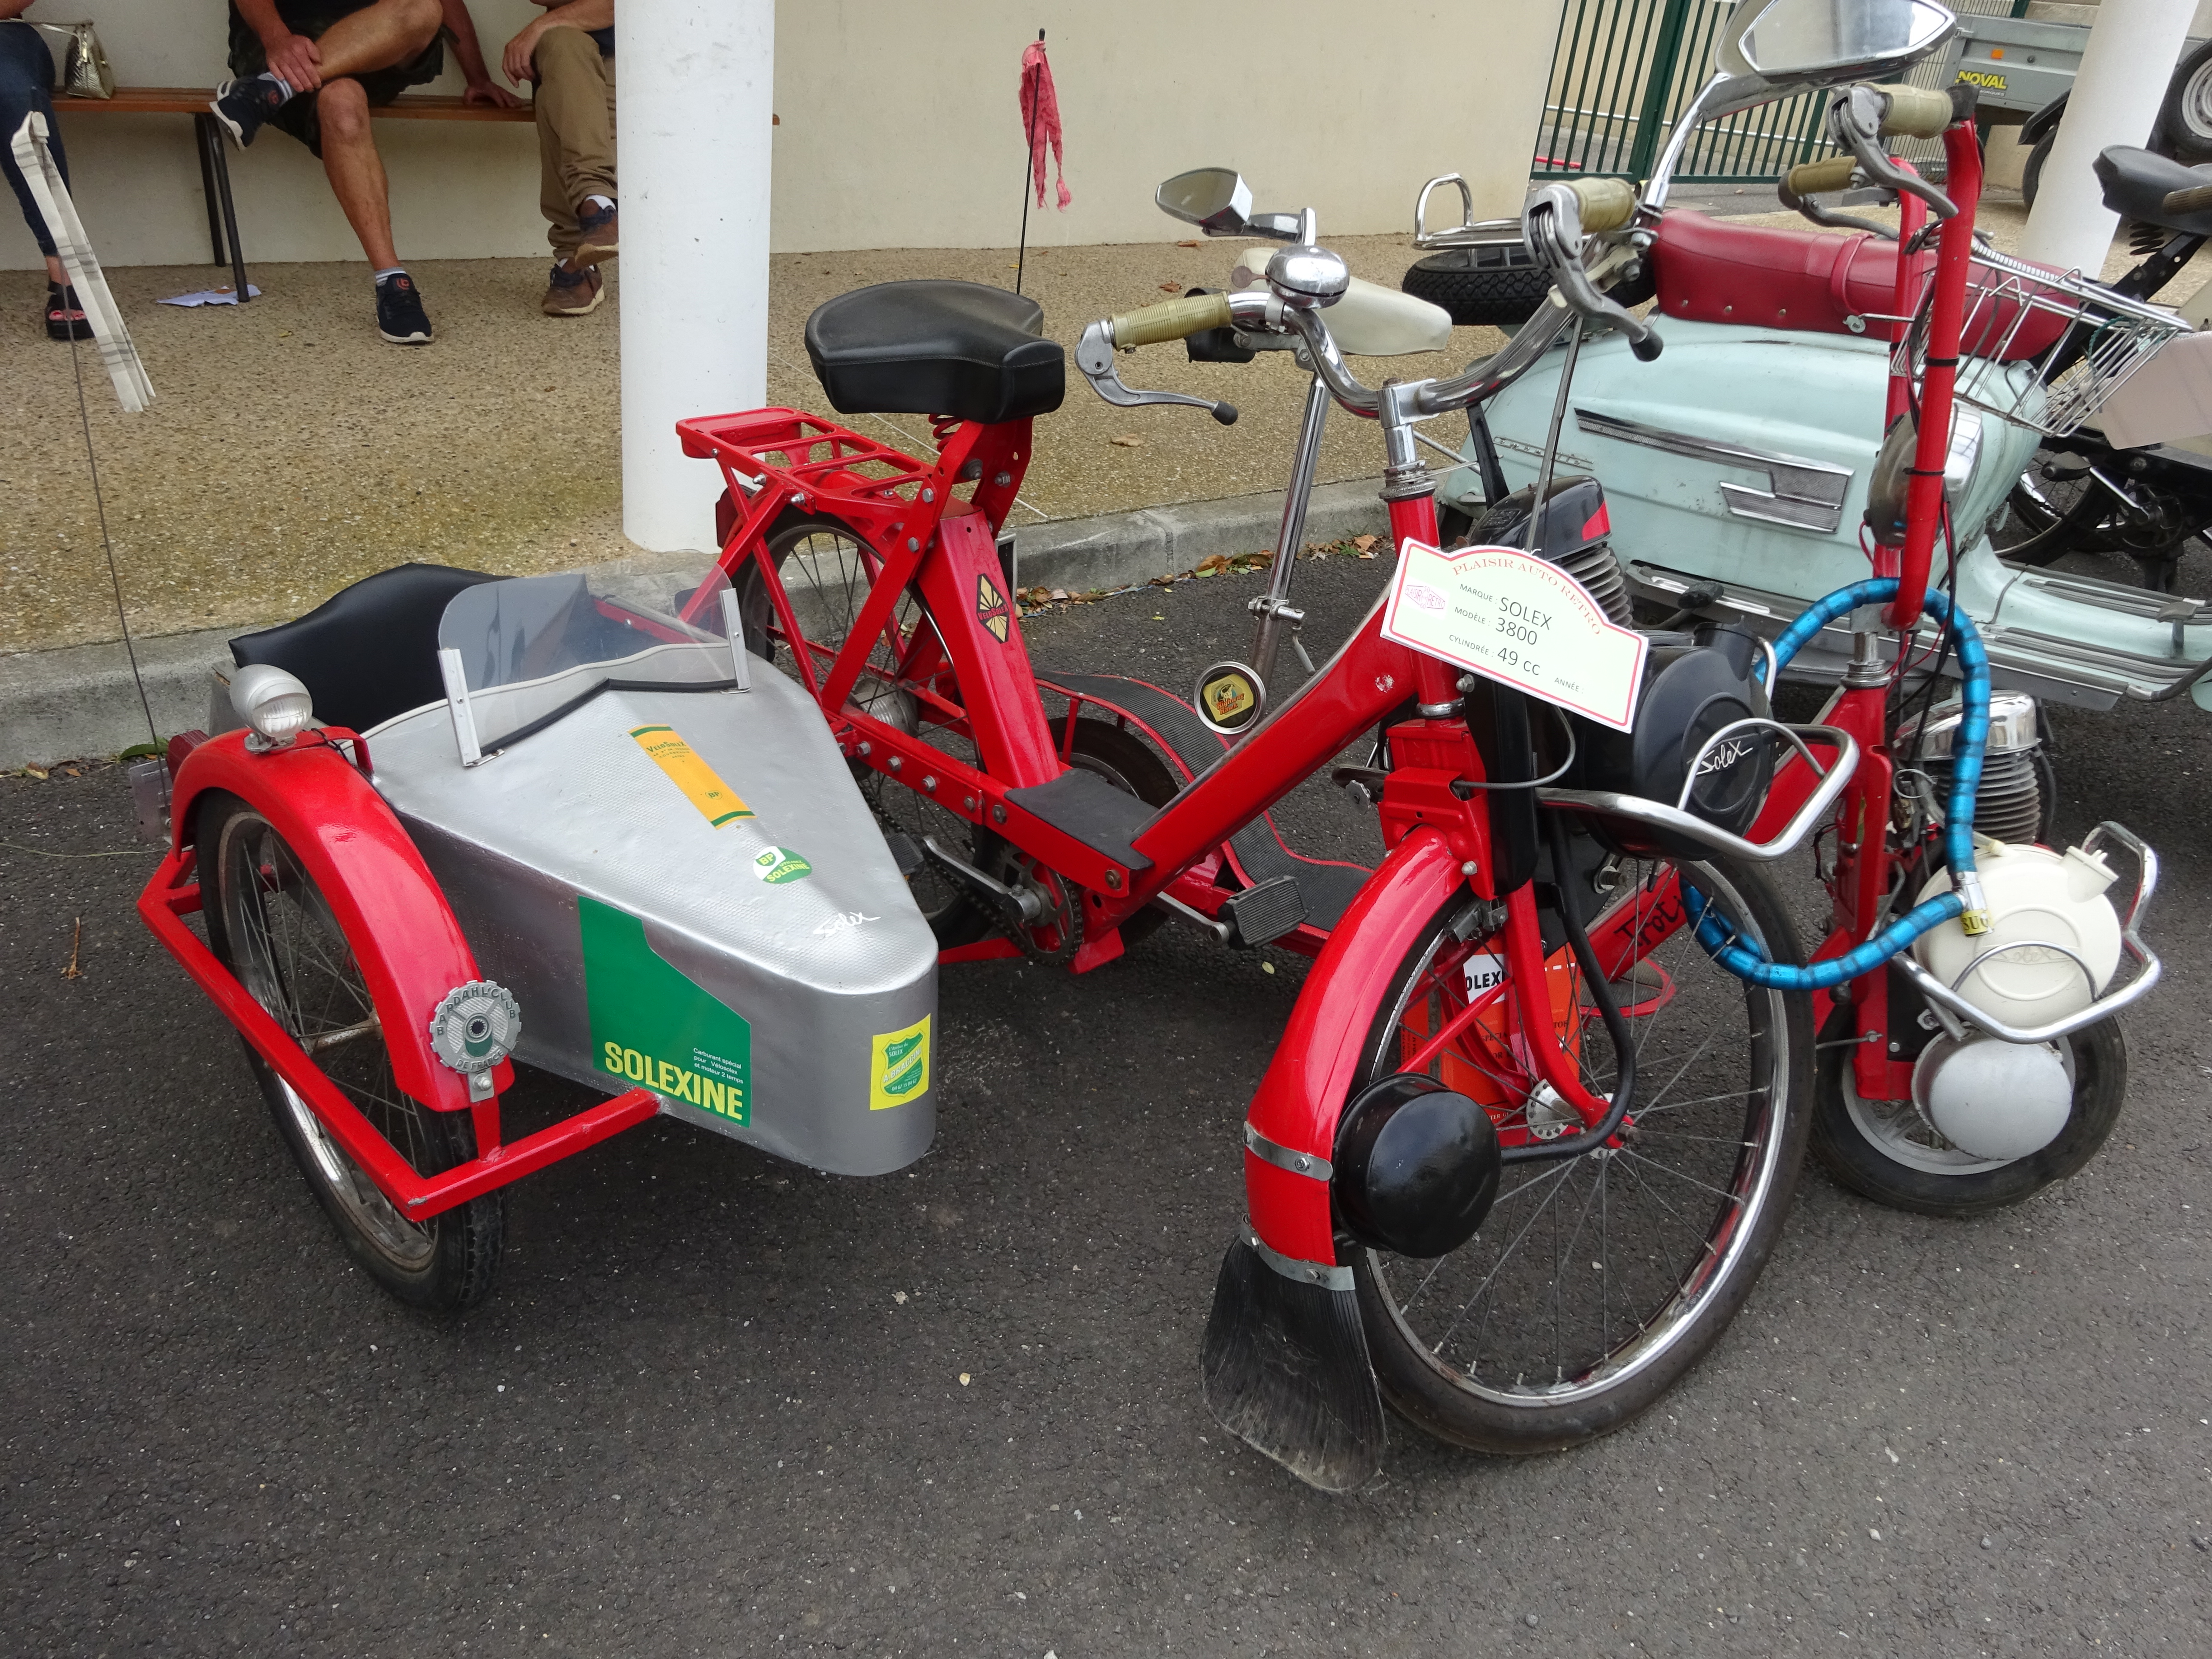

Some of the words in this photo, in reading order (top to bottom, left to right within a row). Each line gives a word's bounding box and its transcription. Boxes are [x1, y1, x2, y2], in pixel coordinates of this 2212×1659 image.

[1405, 586, 1422, 602] PLAISIR
[1427, 594, 1445, 608] RETRO
[1452, 558, 1514, 576] PLAISIR
[1518, 562, 1557, 586] AUTO
[1560, 585, 1600, 635] RETRO
[1460, 583, 1493, 602] MARQUE
[1499, 597, 1552, 630] SOLEX
[1454, 606, 1486, 624] MODÈLE
[1495, 617, 1537, 645] 3800
[1449, 634, 1490, 656] CYLINDRÉE
[1497, 647, 1518, 665] 49
[1554, 677, 1579, 692] ANNÉE
[759, 853, 773, 865] BP
[766, 863, 810, 882] SOLEXINE
[455, 1058, 469, 1069] DE
[470, 1049, 503, 1070] FRANCE
[693, 1048, 721, 1062] Carburant
[722, 1058, 742, 1069] spécial
[889, 1049, 903, 1057] SOLEX
[694, 1055, 707, 1064] pour
[711, 1060, 738, 1075] Vélosolex
[701, 1065, 721, 1075] moteur
[726, 1073, 744, 1084] temps
[605, 1041, 742, 1120] SOLEXINE
